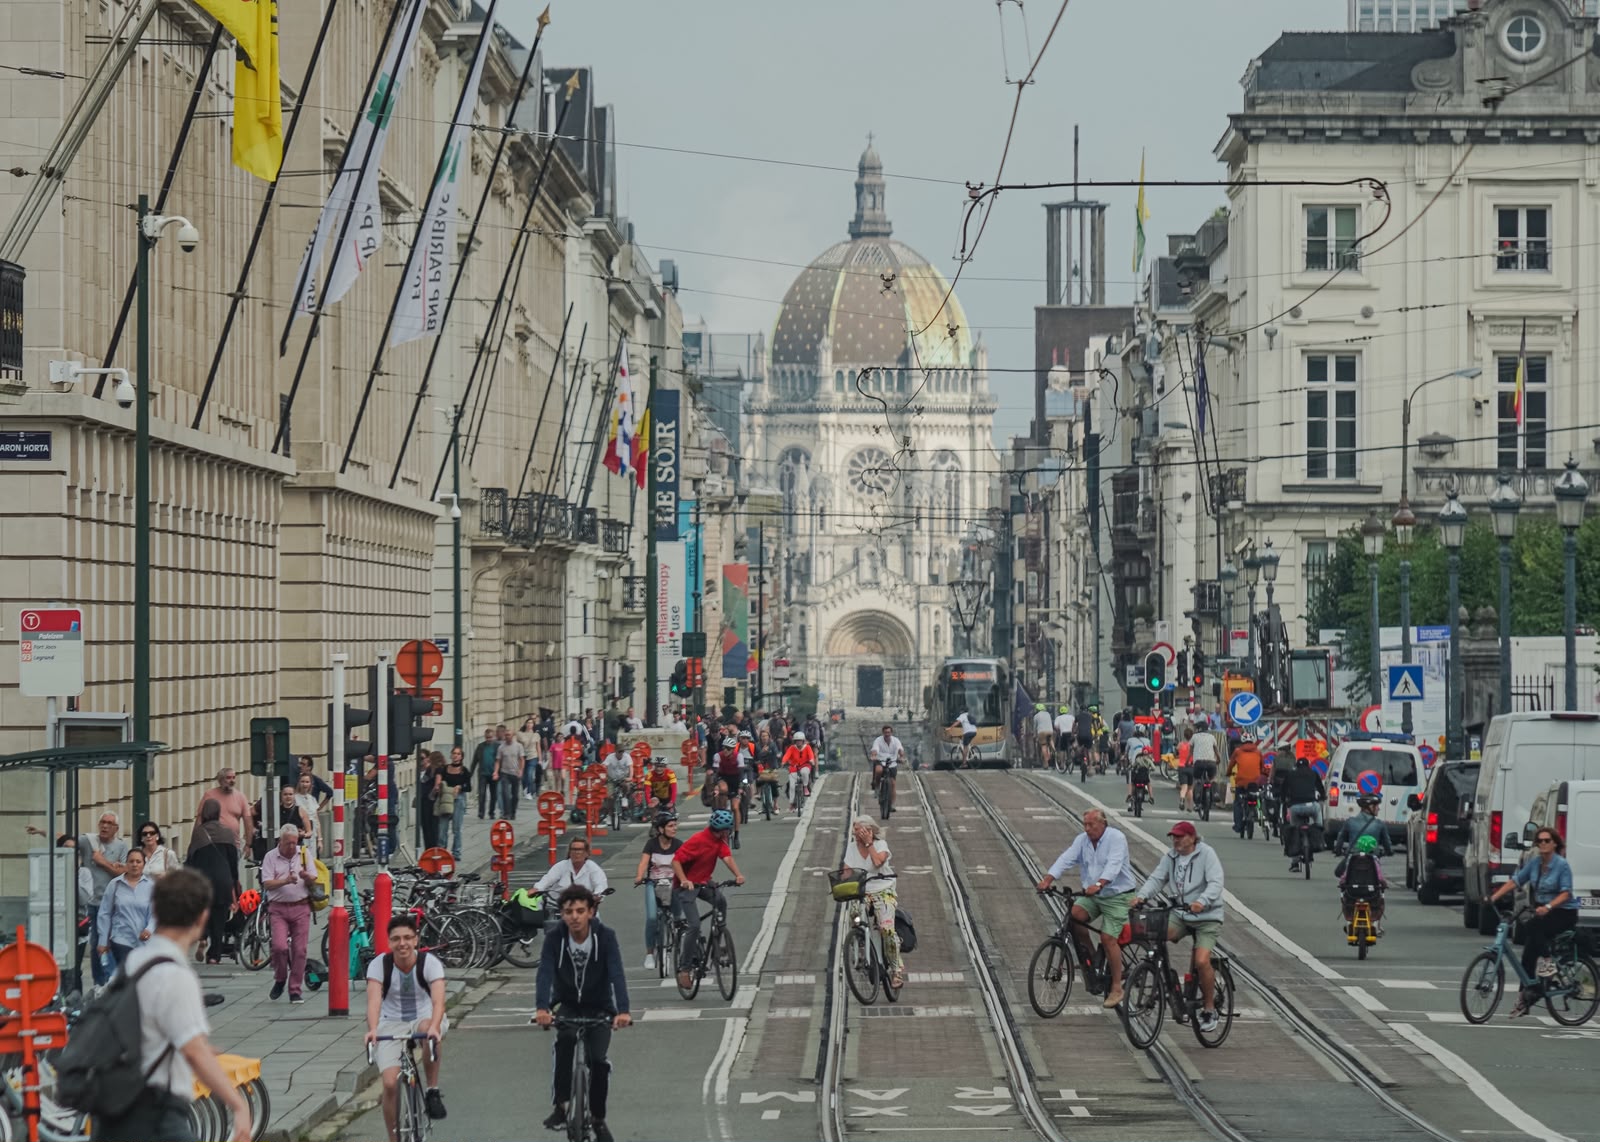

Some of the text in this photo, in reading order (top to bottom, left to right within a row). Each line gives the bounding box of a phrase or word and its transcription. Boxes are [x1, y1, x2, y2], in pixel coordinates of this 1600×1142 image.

[23, 444, 49, 452] HORTA
[655, 420, 676, 483] SOIR
[656, 562, 670, 644] Philanthropy
